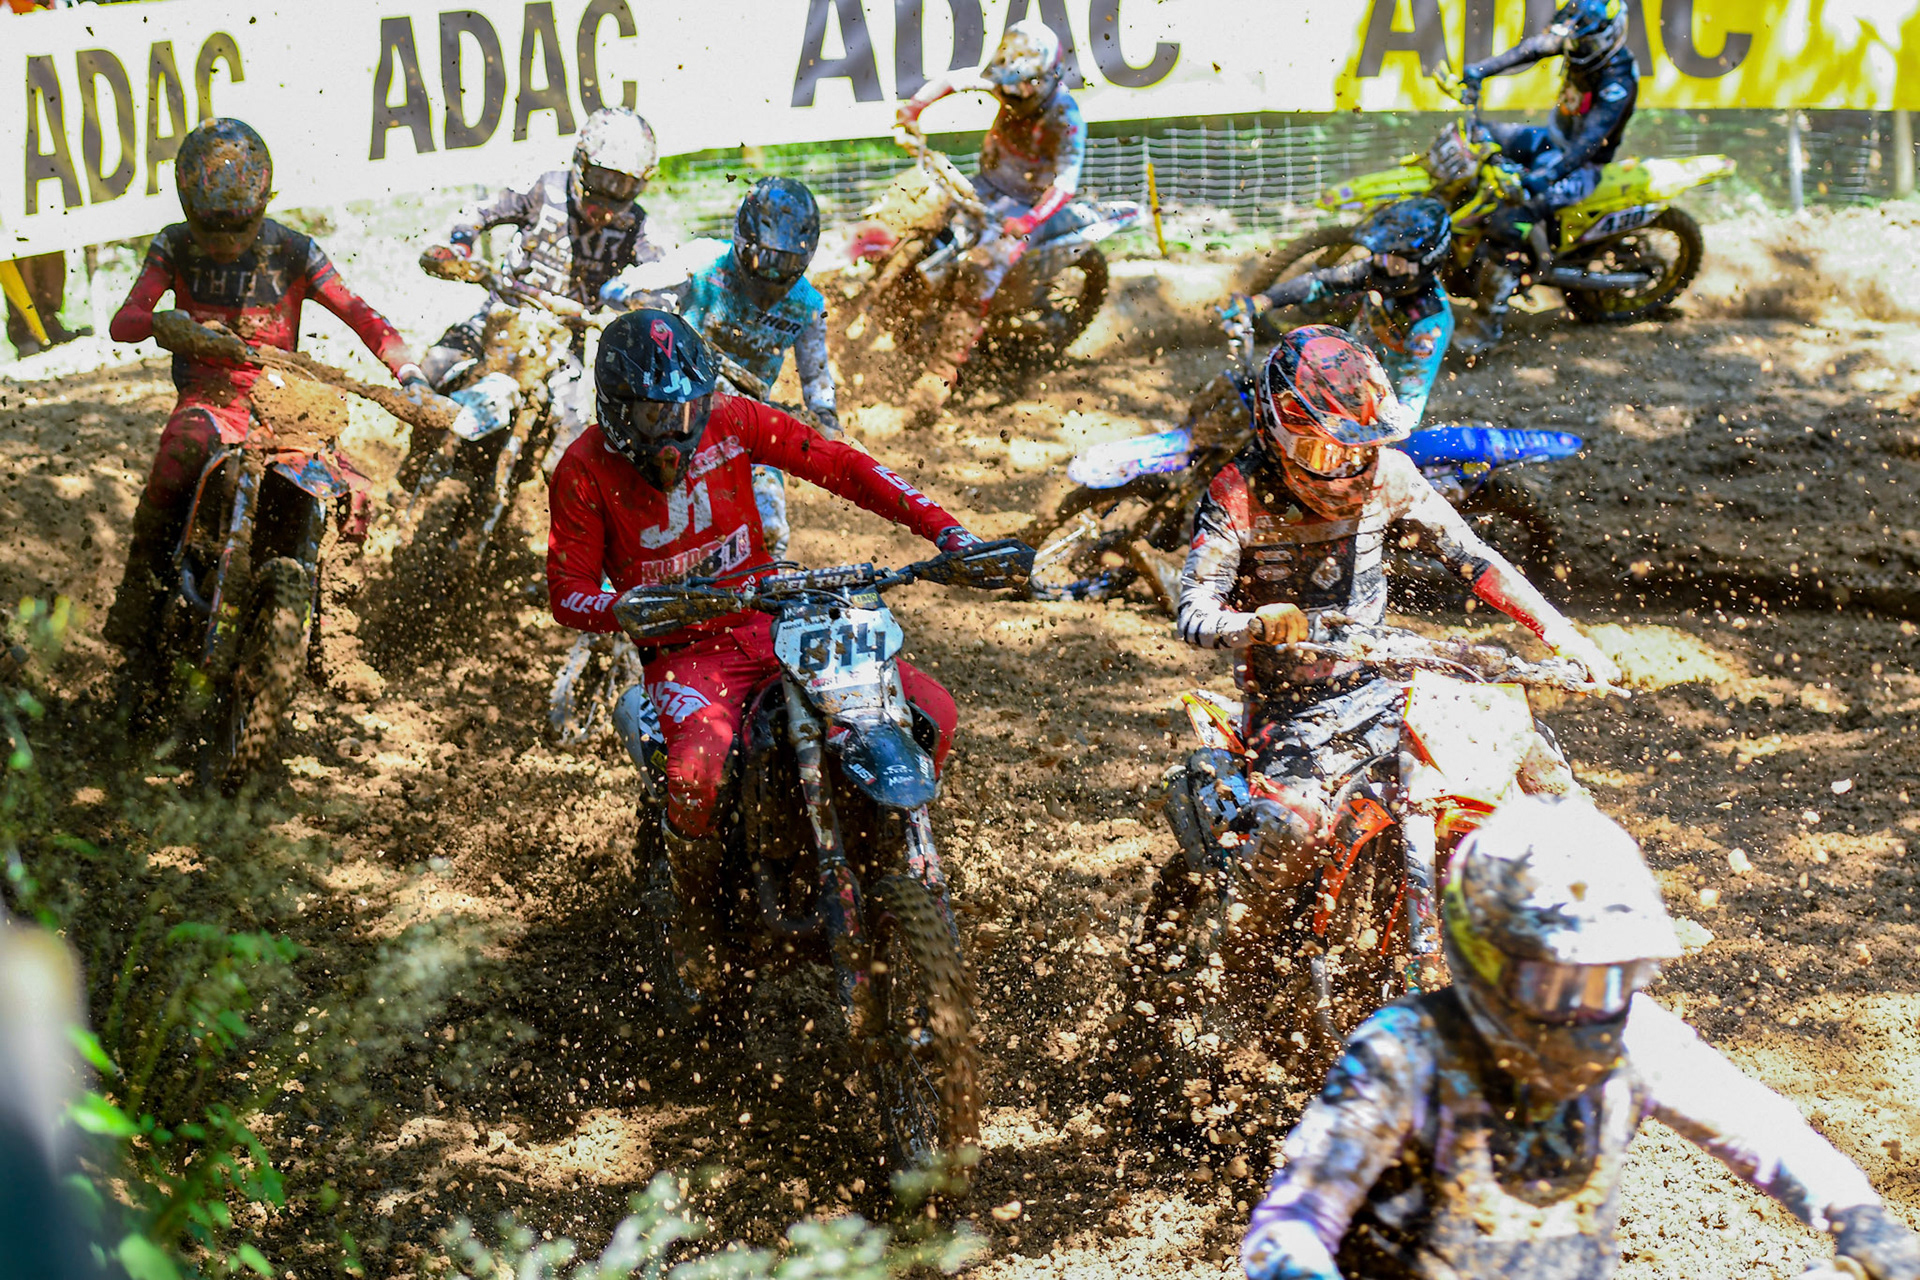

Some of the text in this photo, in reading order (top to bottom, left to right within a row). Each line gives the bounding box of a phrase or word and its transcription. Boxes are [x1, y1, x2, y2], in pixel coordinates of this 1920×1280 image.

[368, 0, 638, 160] ADAC
[1356, 0, 1752, 78] ADC
[25, 32, 244, 215] ADAC
[800, 622, 886, 671] 814
